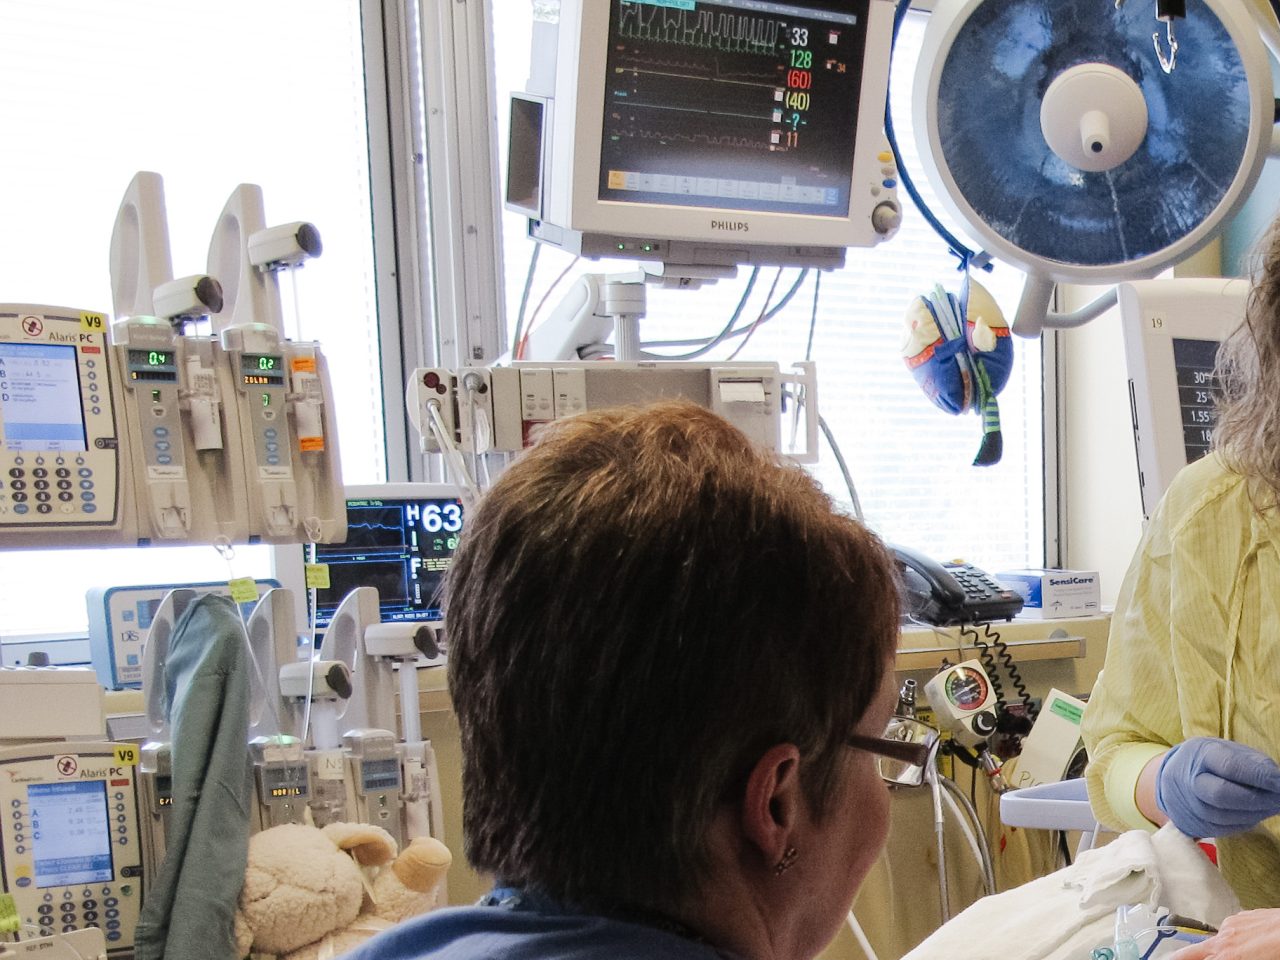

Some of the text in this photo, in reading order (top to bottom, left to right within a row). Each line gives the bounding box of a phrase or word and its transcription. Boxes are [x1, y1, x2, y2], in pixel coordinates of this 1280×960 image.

[791, 27, 808, 46] 33
[790, 49, 812, 68] 128
[787, 70, 812, 89] (60)
[785, 92, 810, 111] (40)
[711, 220, 749, 232] PHILIPS
[85, 316, 101, 328] V9
[1151, 318, 1163, 328] 19
[49, 331, 94, 343] Alaris PC
[1194, 371, 1206, 384] 30
[1196, 391, 1207, 402] 25
[1191, 410, 1210, 422] 1.55
[422, 504, 462, 533] 63
[1049, 577, 1094, 586] SensiCare
[118, 750, 134, 761] V9
[80, 767, 123, 778] Alaris PC
